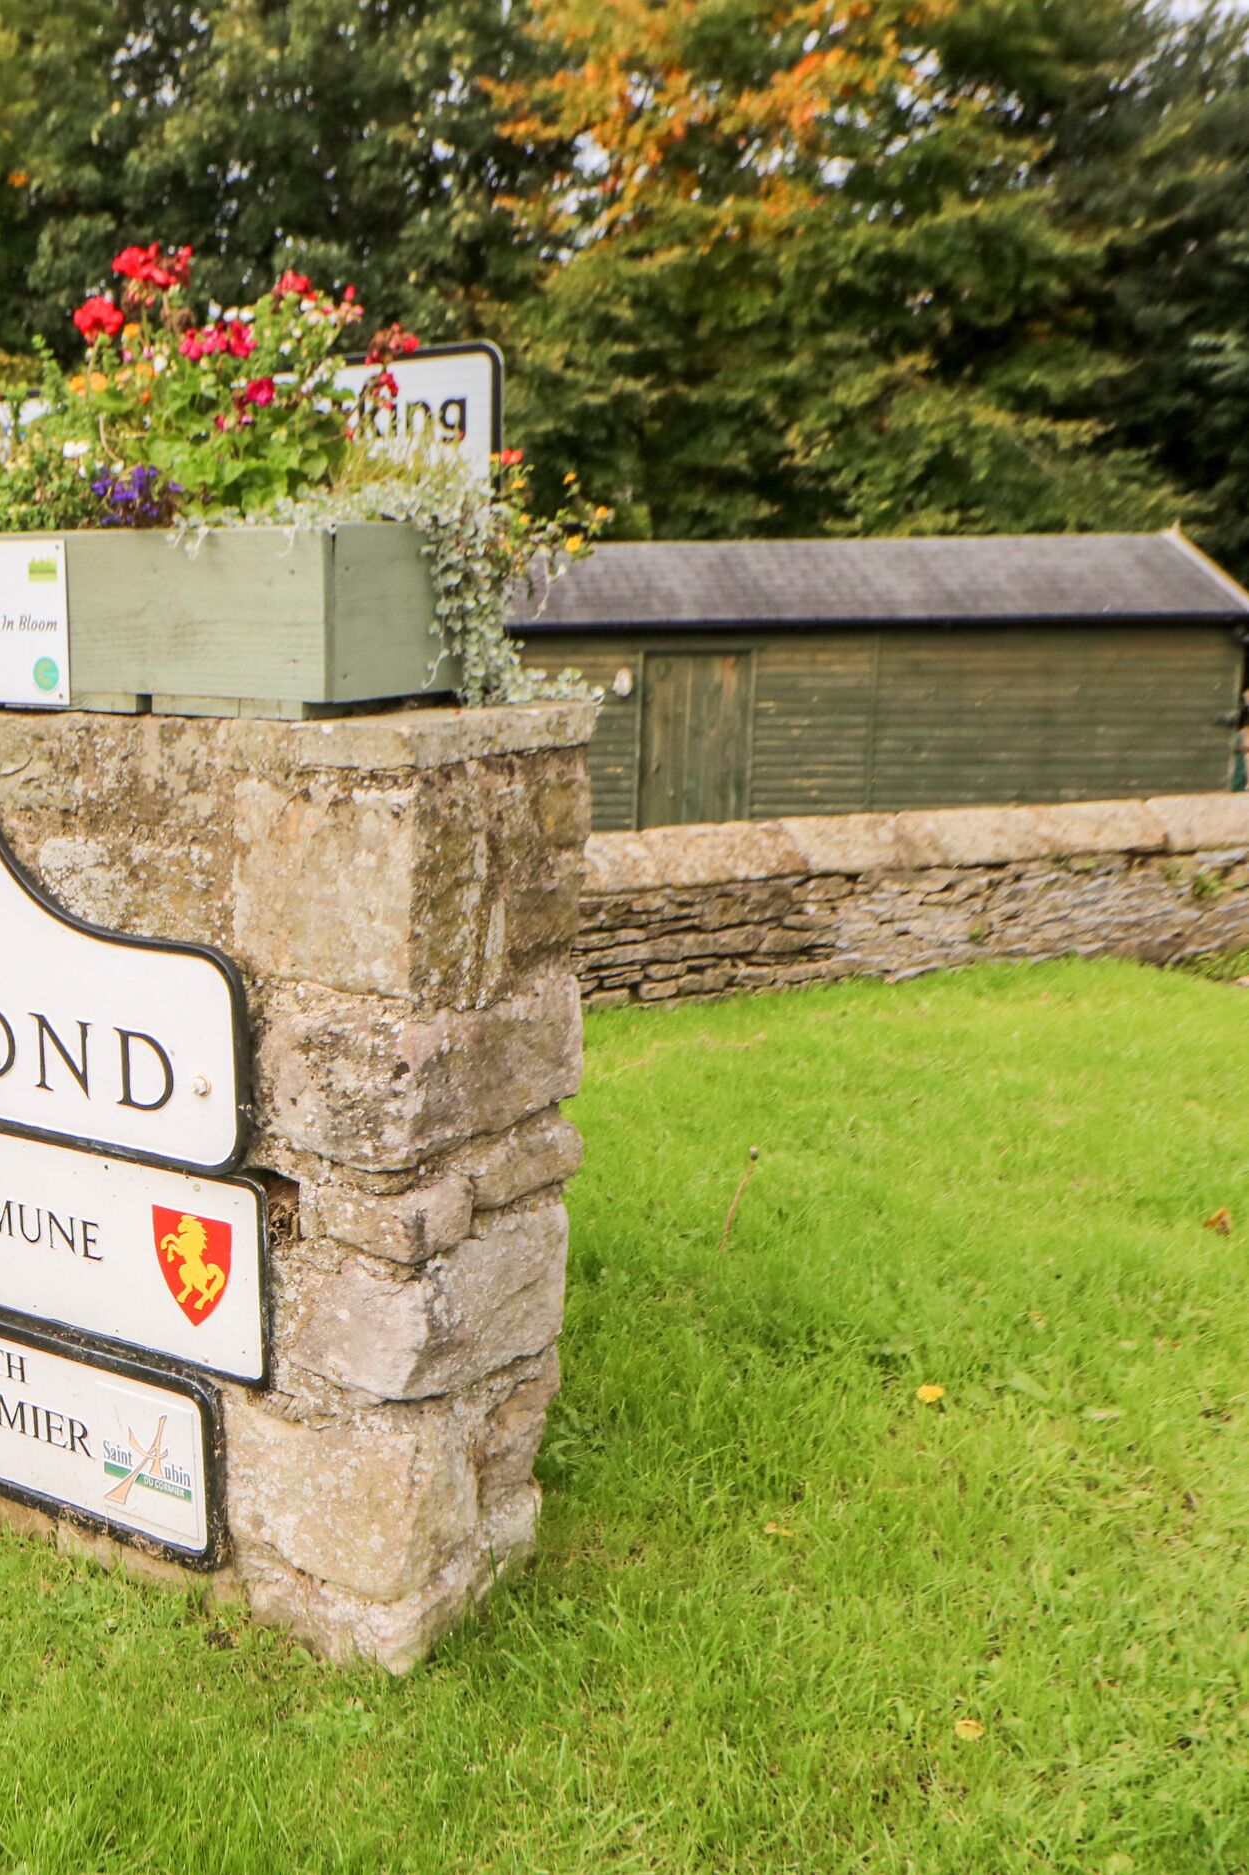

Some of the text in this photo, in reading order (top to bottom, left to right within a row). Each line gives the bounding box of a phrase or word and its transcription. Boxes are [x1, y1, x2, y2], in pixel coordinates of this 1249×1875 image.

[1, 615, 14, 631] In
[18, 615, 58, 631] Bloom
[103, 1439, 133, 1467] Saint
[143, 1475, 185, 1498] DU CORMIER
